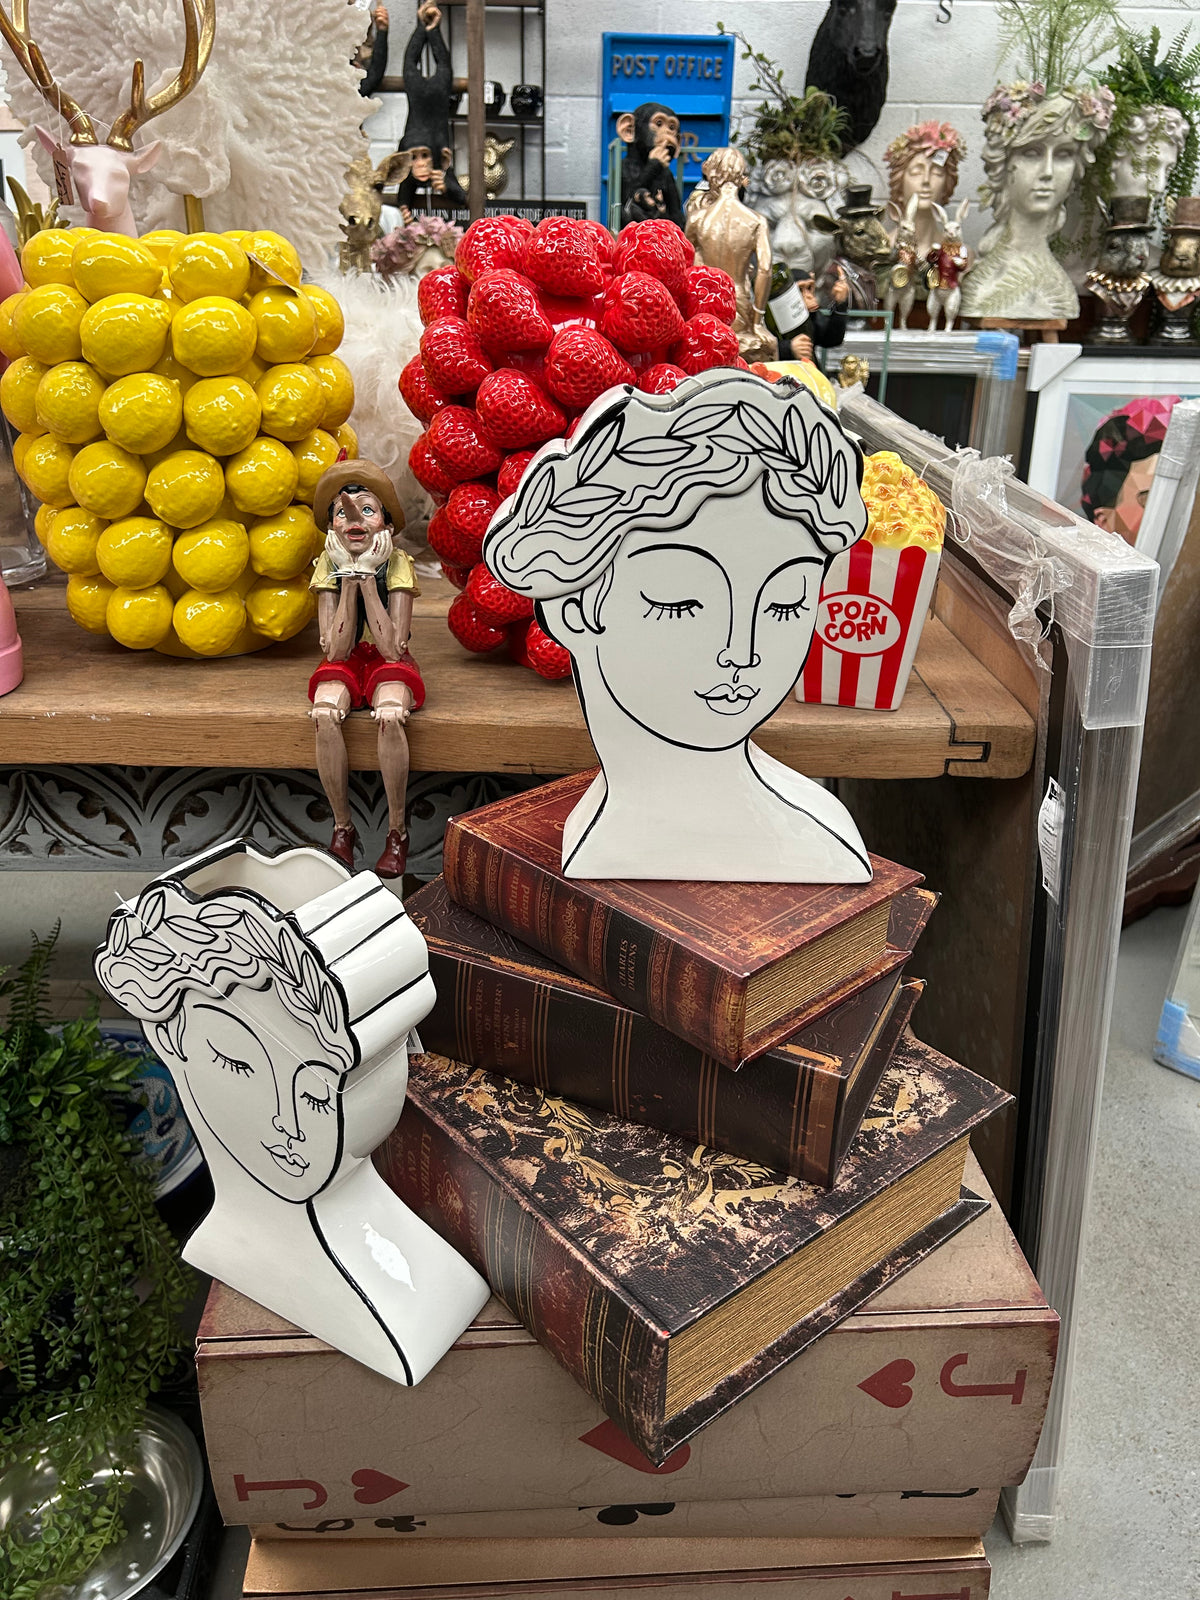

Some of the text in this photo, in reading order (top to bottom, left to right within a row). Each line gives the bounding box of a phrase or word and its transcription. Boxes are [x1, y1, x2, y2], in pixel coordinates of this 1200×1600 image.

[612, 54, 723, 79] POST OFFICE
[517, 208, 542, 222] SIDE
[824, 616, 888, 642] CORN
[827, 601, 880, 622] POP
[520, 884, 531, 929] Friend
[618, 939, 629, 987] CHARLES
[627, 943, 638, 991] DICKENS
[939, 1353, 1027, 1405] J
[233, 1474, 328, 1510] J
